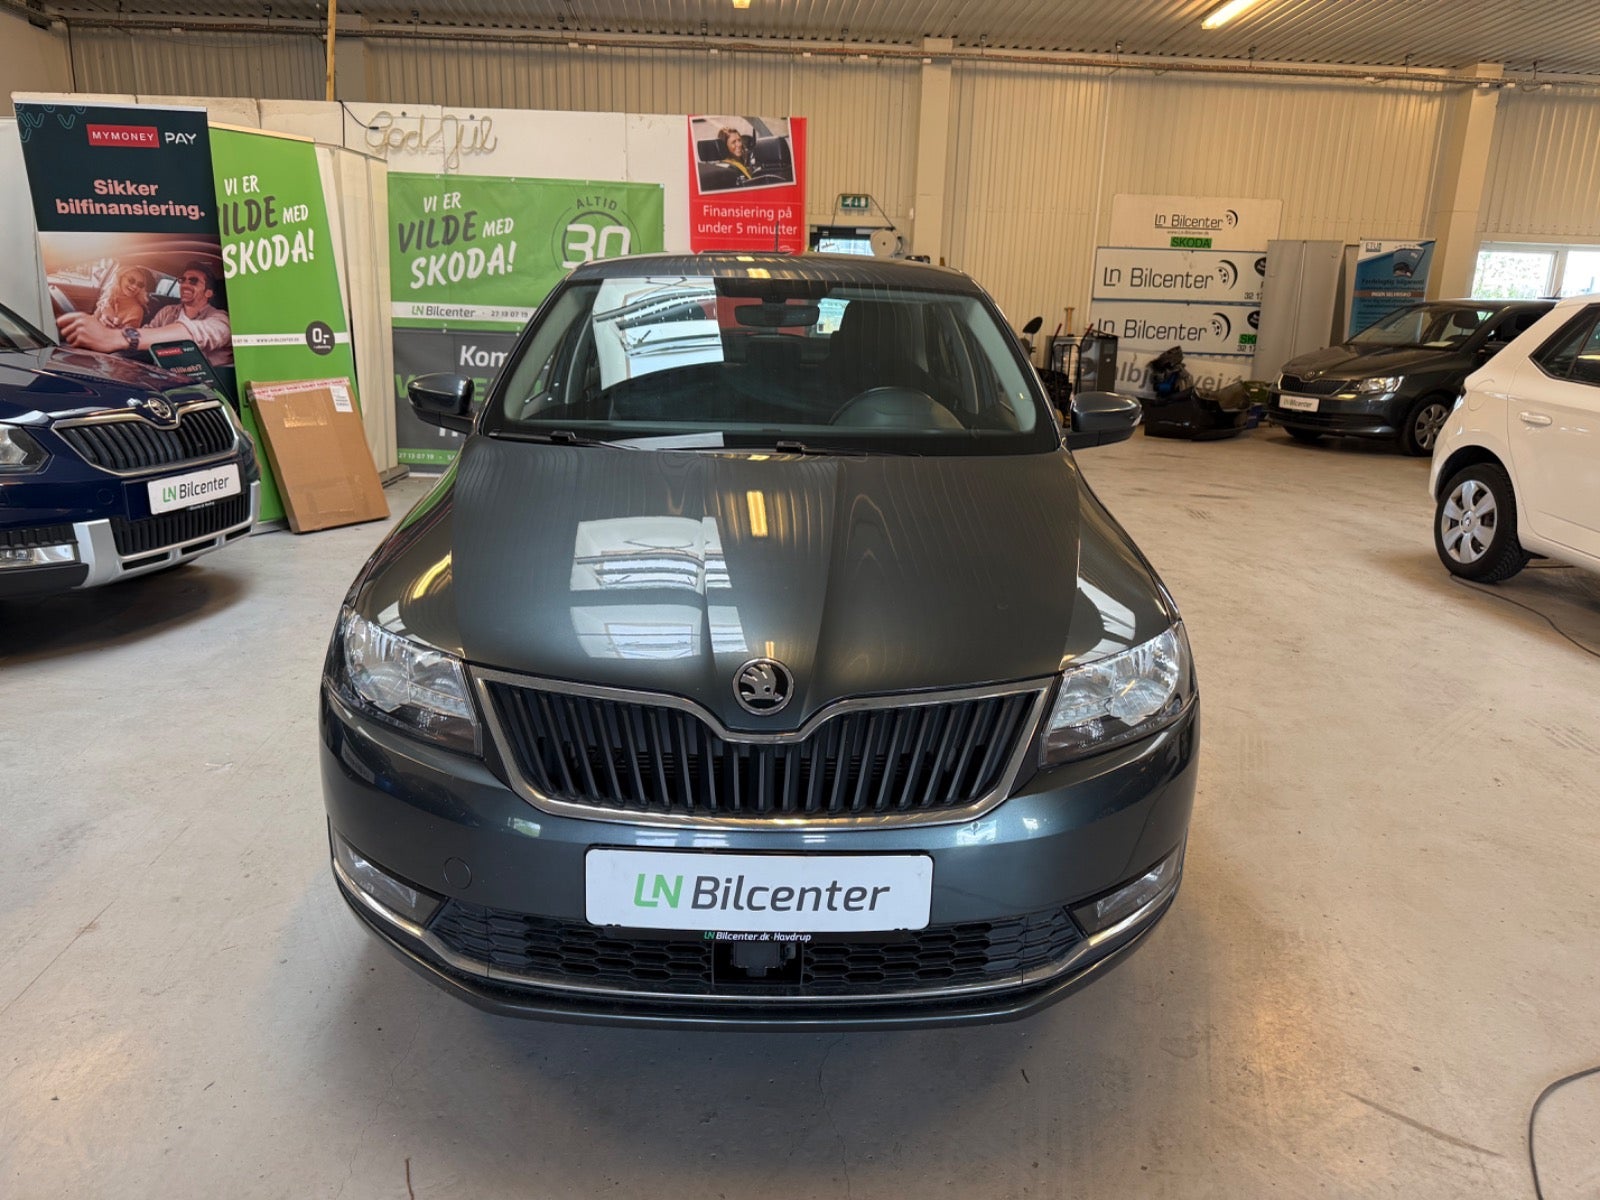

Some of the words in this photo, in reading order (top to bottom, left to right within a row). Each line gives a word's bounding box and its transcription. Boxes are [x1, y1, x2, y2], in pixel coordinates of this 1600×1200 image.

[91, 131, 155, 141] MYMONEY
[164, 132, 197, 145] PAY
[440, 114, 498, 170] Jul
[93, 179, 159, 196] Sikker
[223, 177, 238, 197] VI
[242, 174, 260, 194] ER
[55, 198, 206, 221] bilfinansiering.
[423, 195, 437, 214] VI
[443, 191, 462, 210] ER
[575, 195, 618, 212] ALTID
[703, 204, 775, 221] Finansiering
[778, 205, 793, 222] på
[217, 195, 279, 237] ILDE
[282, 204, 309, 225] MED
[1171, 213, 1224, 229] Bilcenter
[397, 210, 479, 254] VILDE
[482, 217, 514, 239] MED
[697, 222, 734, 234] under
[736, 222, 744, 235] 5
[746, 222, 799, 236] minutter
[222, 227, 315, 279] SKODA!
[561, 223, 632, 270] 30
[1171, 236, 1212, 248] SKODA
[409, 240, 518, 290] SKODA!
[1129, 267, 1214, 290] Bilcenter
[1243, 292, 1254, 300] 32
[411, 304, 425, 316] LN
[426, 305, 476, 318] Bilcenter
[1123, 319, 1208, 341] Bilcenter
[162, 485, 177, 503] LN
[178, 475, 230, 500] Bilcenter
[633, 872, 683, 909] LN
[690, 874, 890, 913] Bilcenter
[703, 931, 716, 940] LN
[716, 931, 770, 941] Bilcenter.dk
[773, 932, 812, 943] Havdrup
